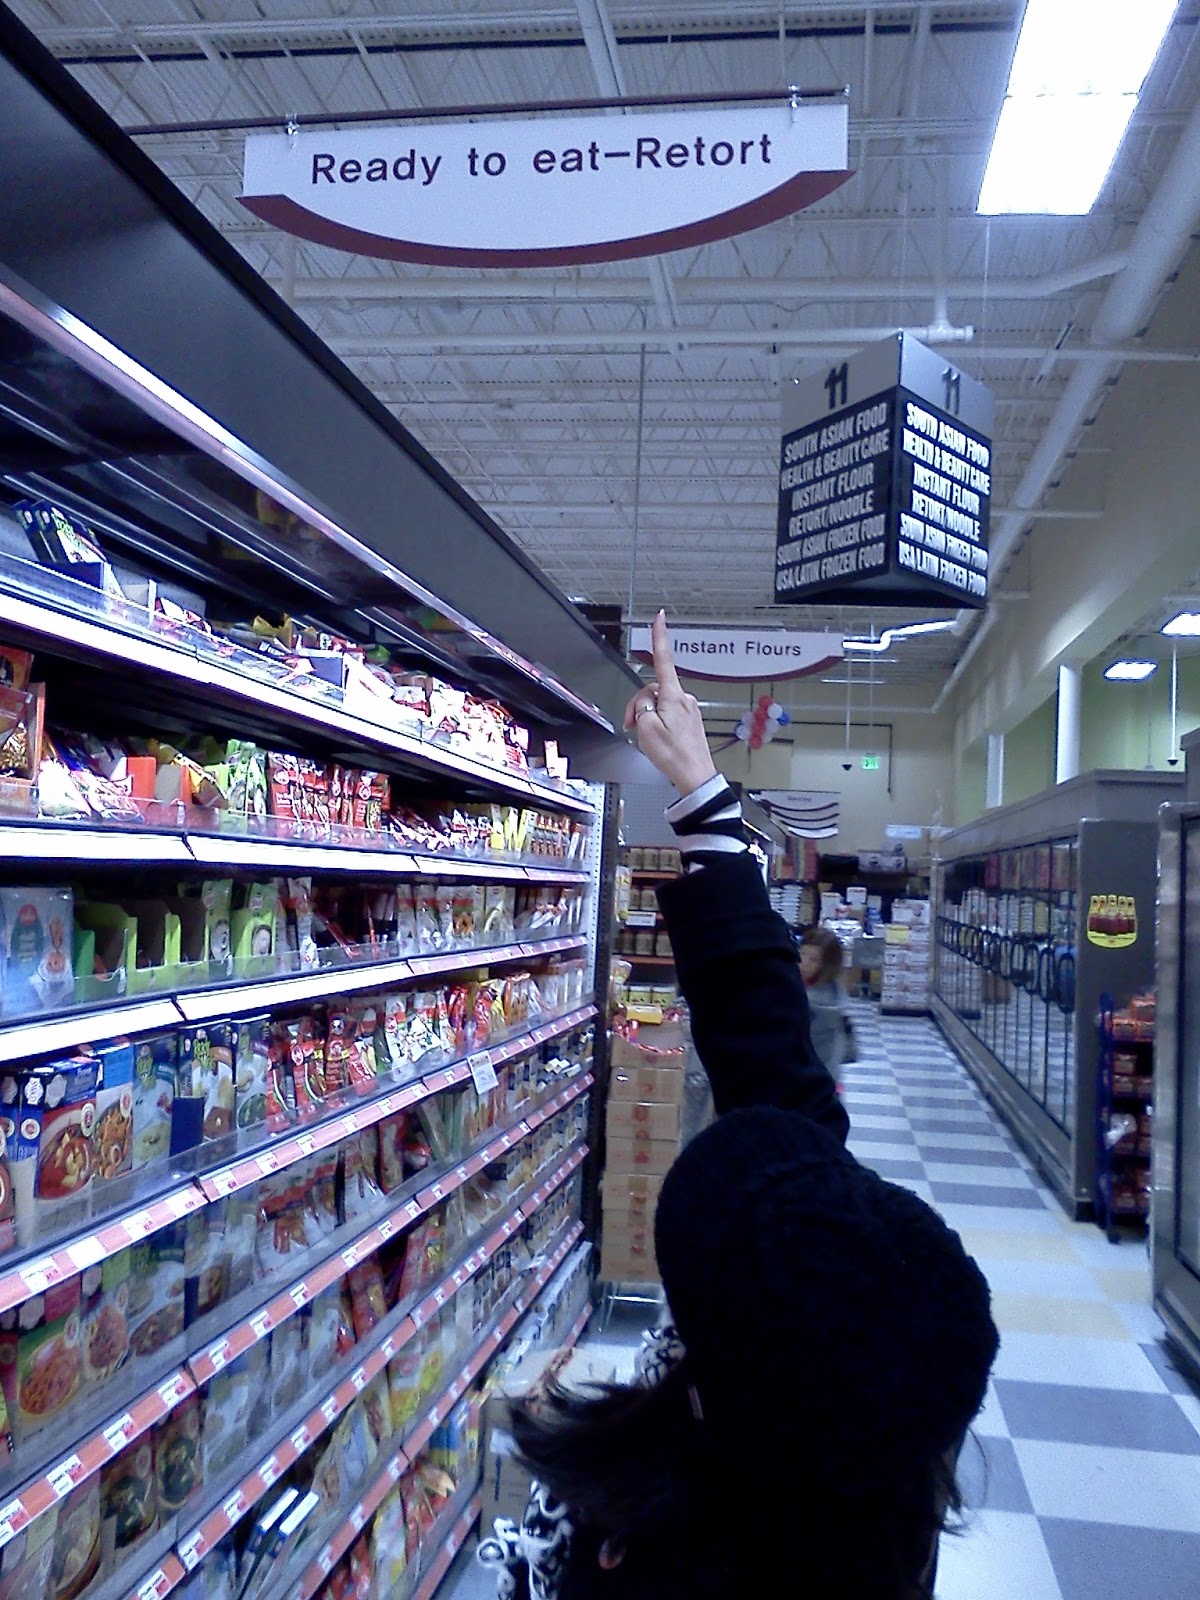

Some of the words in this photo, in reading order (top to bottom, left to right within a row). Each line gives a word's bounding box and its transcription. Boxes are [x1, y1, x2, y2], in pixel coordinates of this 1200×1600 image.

[311, 147, 442, 186] Ready
[467, 147, 506, 177] to
[825, 362, 848, 410] 11
[781, 460, 814, 490] HEALTH
[814, 455, 824, 478] &
[824, 439, 860, 473] BEAUTY
[861, 428, 890, 457] CARE
[784, 434, 818, 464] SOUTH
[820, 412, 854, 447] ASIAN
[856, 402, 887, 432] FOOD
[907, 402, 937, 439] SOUTH
[938, 421, 966, 452] ASIAN
[966, 441, 989, 468] FOOD
[791, 476, 836, 511] INSTANT
[838, 462, 874, 493] FLOUR
[903, 428, 934, 461] HEALTH
[934, 444, 942, 467] &
[941, 451, 970, 480] BEAUTY
[969, 467, 990, 496] CARE
[913, 462, 950, 500] INSTANT
[951, 485, 980, 515] FLOUR
[777, 540, 801, 566] SOUTH
[827, 519, 860, 551] FROZEN
[861, 513, 886, 538] FOOD
[776, 567, 795, 591] USA
[795, 559, 820, 587] LATIN
[820, 550, 857, 580] FROZEN
[858, 542, 886, 570] FOOD
[673, 639, 735, 655] Instant
[745, 641, 801, 656] Flours
